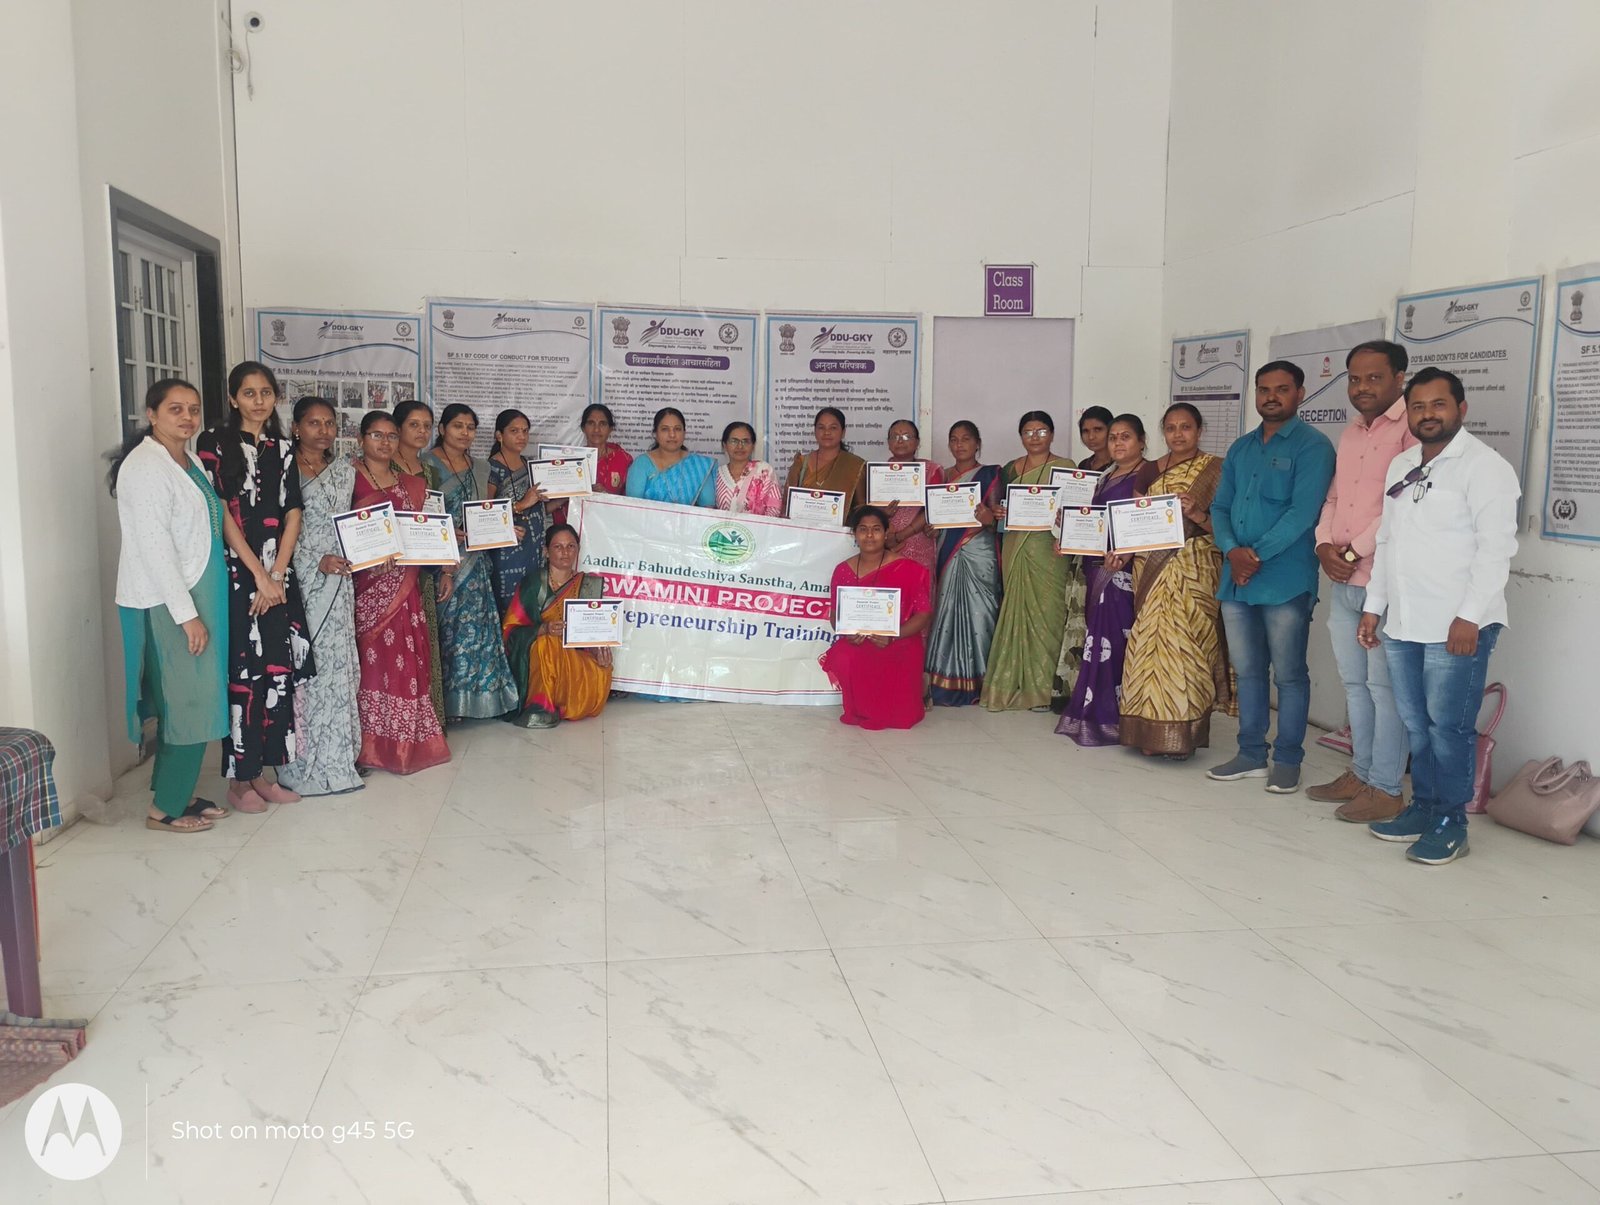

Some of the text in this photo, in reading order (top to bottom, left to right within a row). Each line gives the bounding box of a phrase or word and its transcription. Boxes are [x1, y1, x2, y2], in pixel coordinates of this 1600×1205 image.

[993, 271, 1024, 287] Class
[993, 294, 1024, 310] Room
[1454, 303, 1479, 313] DDU-GKY
[331, 324, 364, 332] DDU-GKY
[660, 327, 705, 337] DDU-GKY
[830, 333, 873, 342] DDU-GKY
[1581, 345, 1590, 354] SF
[1424, 354, 1436, 362] AND
[1457, 352, 1468, 360] FOR
[1469, 350, 1507, 359] CANDIDATES
[681, 357, 721, 367] आचारसंहिता
[815, 360, 867, 371] अनुदान परिपत्रक
[1300, 408, 1347, 422] RECEPTION
[582, 554, 831, 593] Aadhar Bahuddeshiya Sanstha, Ama
[602, 576, 710, 604] SWAMINI
[623, 609, 758, 640] epreneurship
